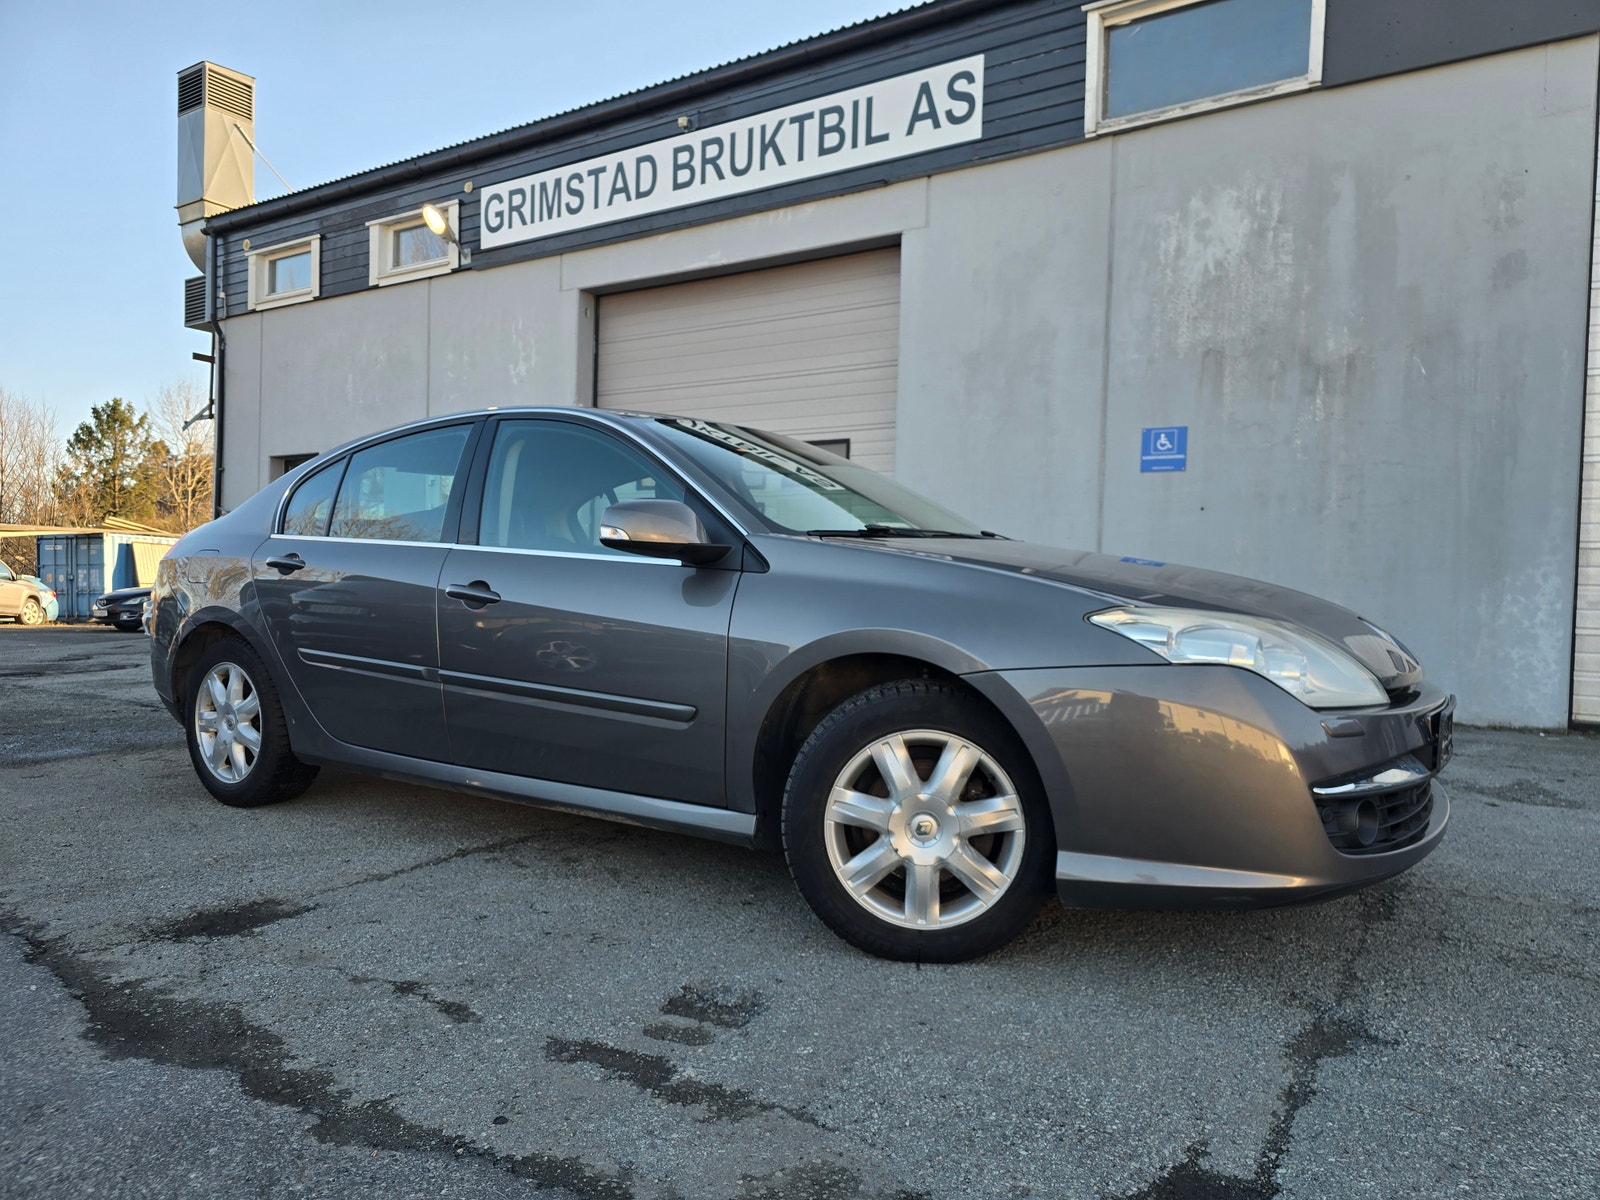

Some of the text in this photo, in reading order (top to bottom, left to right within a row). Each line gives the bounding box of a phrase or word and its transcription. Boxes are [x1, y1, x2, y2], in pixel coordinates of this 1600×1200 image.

[484, 70, 976, 233] GRIMSTAD BRUKTBIL AS
